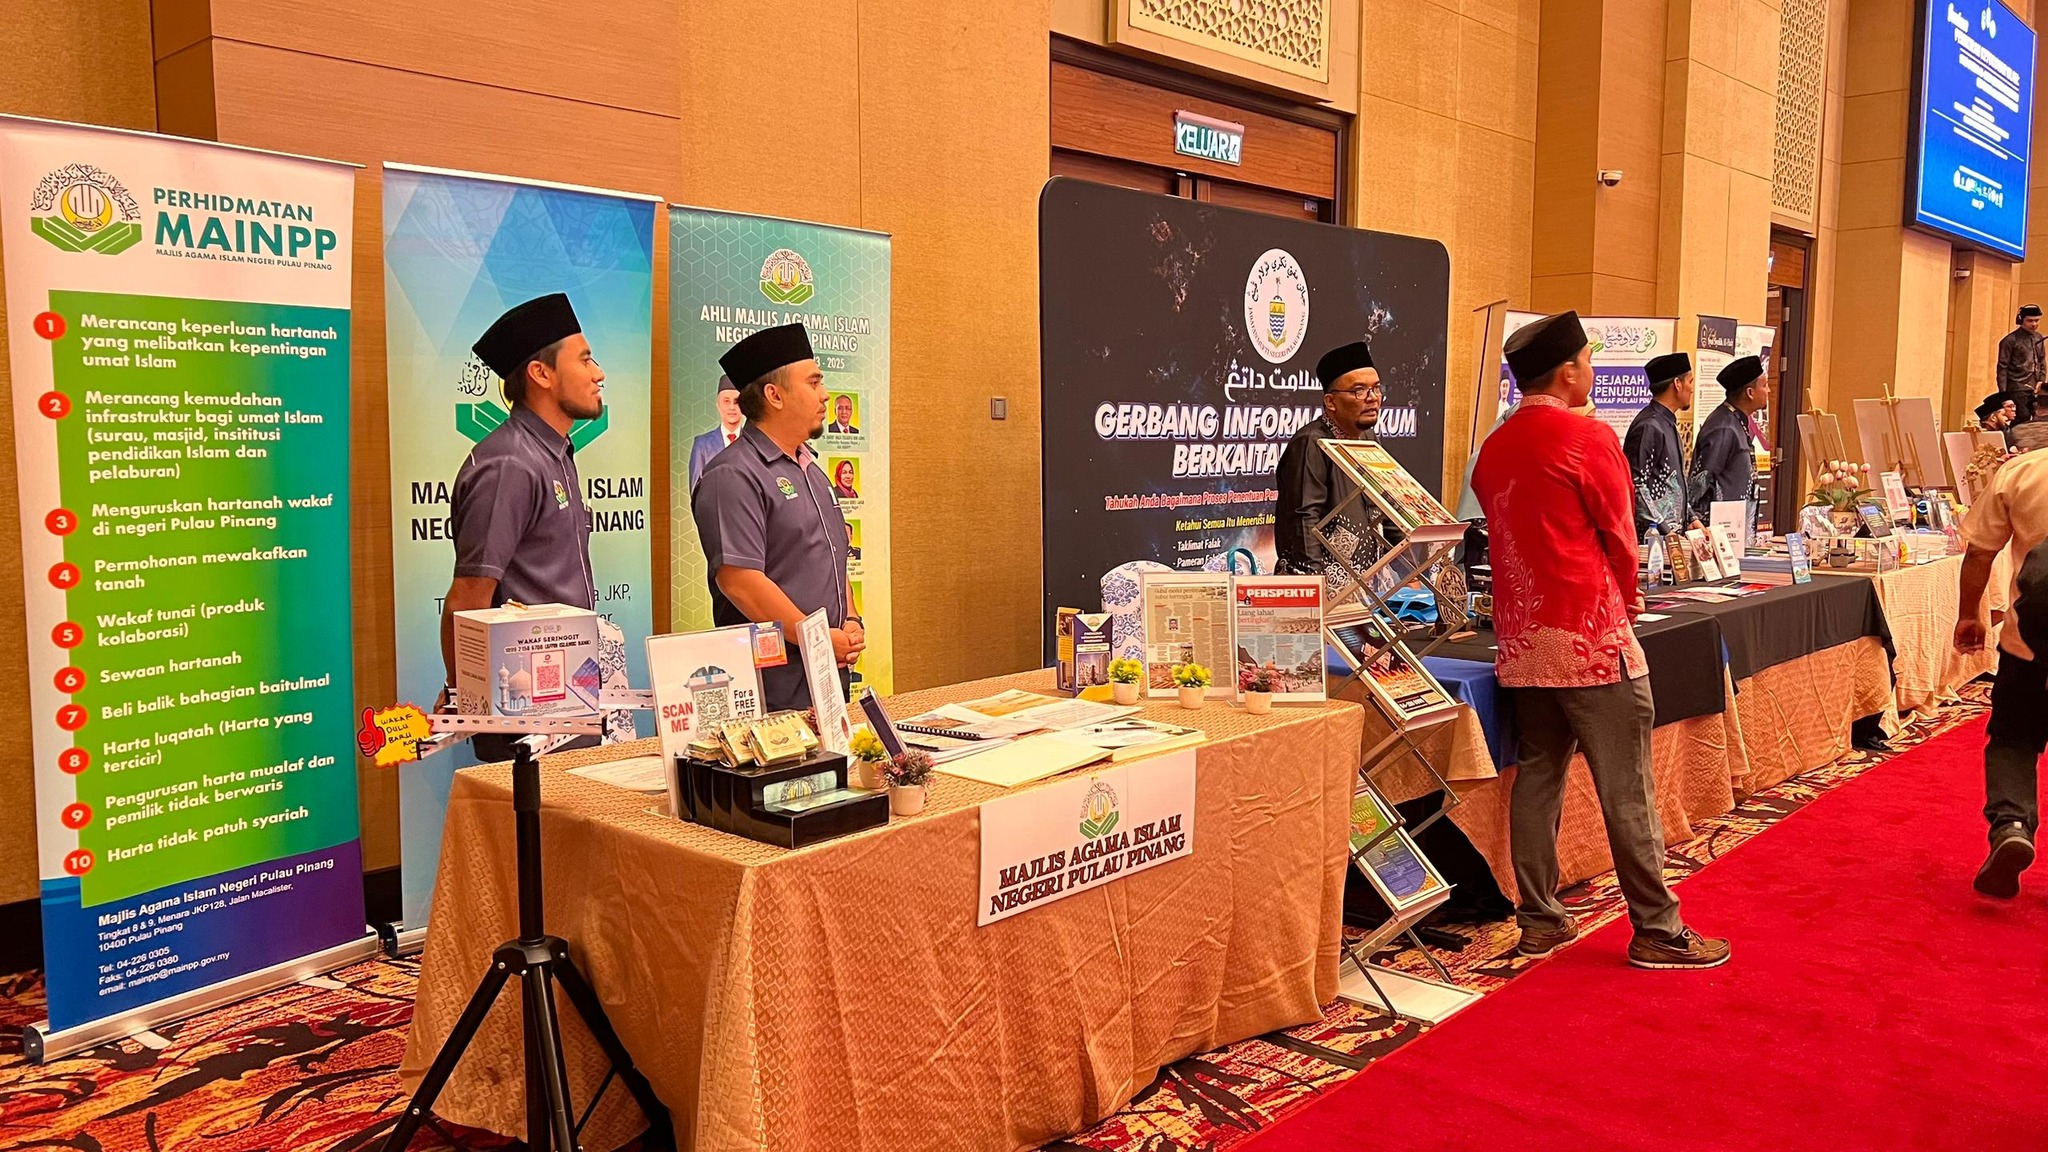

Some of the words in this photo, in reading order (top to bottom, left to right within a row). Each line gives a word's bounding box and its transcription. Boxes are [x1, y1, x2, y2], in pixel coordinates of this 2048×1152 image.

[1177, 122, 1228, 160] KELUAR
[153, 187, 313, 222] PERHIDMATAN
[155, 211, 337, 260] MAINPP
[156, 249, 182, 257] MAJLIS
[185, 252, 216, 260] AGAMA
[219, 254, 244, 262] ISLAM
[247, 257, 274, 265] NEGERI
[277, 260, 302, 268] PULAU
[304, 262, 332, 270] PINANG
[81, 314, 177, 334] Merancang
[182, 318, 266, 339] keperluan
[271, 324, 337, 340] hartanah
[700, 305, 730, 322] AHLI
[735, 308, 778, 326] MAJLIS
[835, 317, 870, 334] ISLAM
[81, 337, 128, 352] yang
[134, 337, 224, 352] melibatkan
[230, 342, 326, 358] kepentingan
[812, 334, 858, 352] PINANG
[83, 355, 129, 367] umat
[136, 355, 177, 368] Islam
[827, 357, 844, 369] 2025
[1595, 375, 1644, 385] SEJARAH
[1595, 386, 1653, 396] PENUBUHA
[86, 391, 179, 408] Merancang
[184, 392, 282, 406] kemudahan
[86, 410, 190, 423] infrastruktur
[196, 409, 232, 426] bagi
[238, 412, 279, 423] umat
[284, 410, 322, 424] Islam
[1095, 402, 1219, 440] GERBANG
[1374, 408, 1416, 437] KUM
[88, 429, 148, 445] (surau,
[153, 428, 208, 443] masjid,
[214, 428, 280, 441] insititusi
[88, 446, 181, 464] pendidikan
[187, 446, 229, 458] Islam
[236, 446, 267, 458] dan
[1173, 444, 1288, 478] BERKAITA
[89, 462, 180, 483] pelaburan)
[588, 477, 642, 499] ISLAM
[92, 500, 202, 519] Menguruskan
[208, 496, 282, 511] hartanah
[288, 494, 333, 508] wakaf
[1105, 493, 1138, 510] Tahukah
[1140, 494, 1160, 508] Anda
[1161, 492, 1202, 510] Bagaimana
[1203, 491, 1227, 505] Proses
[1228, 490, 1264, 504] Penentuan
[93, 522, 109, 536] di
[115, 519, 166, 537] negeri
[171, 516, 214, 531] Pulau
[221, 515, 277, 530] Pinang
[1176, 518, 1202, 531] Ketahui
[1203, 518, 1225, 529] Semua
[1226, 517, 1235, 528] Itu
[1236, 514, 1265, 527] Menerusi
[1178, 539, 1204, 551] Taklimat
[1205, 538, 1221, 549] Falak
[95, 553, 197, 573] Permohonan
[202, 547, 307, 563] mewakafkan
[1177, 557, 1204, 568] Pameran
[95, 576, 145, 591] tanah
[605, 584, 630, 601] JKP,
[1246, 588, 1316, 598] PERSPEKTIF
[97, 608, 153, 628] Wakaf
[157, 605, 195, 621] tunai
[201, 598, 265, 620] (produk
[98, 623, 189, 646] kolaborasi)
[543, 634, 579, 642] SERINGGIT
[100, 663, 165, 683] Sewaan
[169, 652, 241, 672] hartanah
[102, 704, 132, 720] Beli
[138, 696, 175, 714] balik
[180, 685, 255, 706] bahagian
[260, 674, 330, 694] baitulmal
[734, 690, 746, 699] For
[735, 698, 755, 710] FREE
[381, 714, 412, 725] WAKAF
[663, 702, 693, 718] SCAN
[103, 738, 150, 755] Harta
[155, 723, 214, 745] luqatah
[219, 715, 269, 736] (Harta
[274, 711, 313, 729] yang
[386, 724, 408, 733] DULU
[671, 718, 689, 732] ME
[389, 732, 411, 743] BARU
[103, 749, 162, 773] tercicir)
[106, 778, 198, 809] Pengurusan
[203, 770, 245, 788] harta
[250, 761, 304, 780] mualaf
[308, 754, 334, 769] dan
[106, 802, 163, 830] pemilik
[168, 793, 209, 813] tidak
[214, 780, 283, 803] berwaris
[69, 856, 90, 868] 10
[107, 843, 153, 862] Harta
[158, 829, 198, 850] tidak
[203, 819, 248, 842] patuh
[252, 807, 309, 829] syariah
[999, 851, 1066, 889] MAJLIS
[1069, 831, 1130, 867] AGAMA
[1133, 814, 1181, 845] ISLAM
[990, 873, 1064, 915] NEGERI
[1067, 854, 1124, 889] PULAU
[1126, 833, 1185, 868] PINANG
[98, 904, 136, 926] Majlis
[139, 896, 180, 917] Agama
[184, 887, 216, 902] Islam
[219, 875, 257, 894] Negeri
[260, 868, 293, 882] Pulau
[296, 858, 334, 875] Pinang
[98, 926, 130, 941] Tingkat
[132, 924, 138, 932] 8
[140, 922, 146, 930] &
[158, 910, 190, 924] Menara
[229, 894, 250, 905] Jalan
[99, 940, 126, 952] 10400
[129, 932, 152, 944] Pulau
[154, 922, 183, 938] Pinang
[99, 964, 114, 974] Tel:
[116, 954, 146, 969] 04-226
[149, 947, 170, 958] 0305
[99, 973, 123, 984] Faks:
[126, 963, 154, 977] 04-226
[157, 955, 178, 967] 0380
[99, 984, 126, 995] email:
[128, 951, 230, 989] mainpp@mainpp.gov.my
